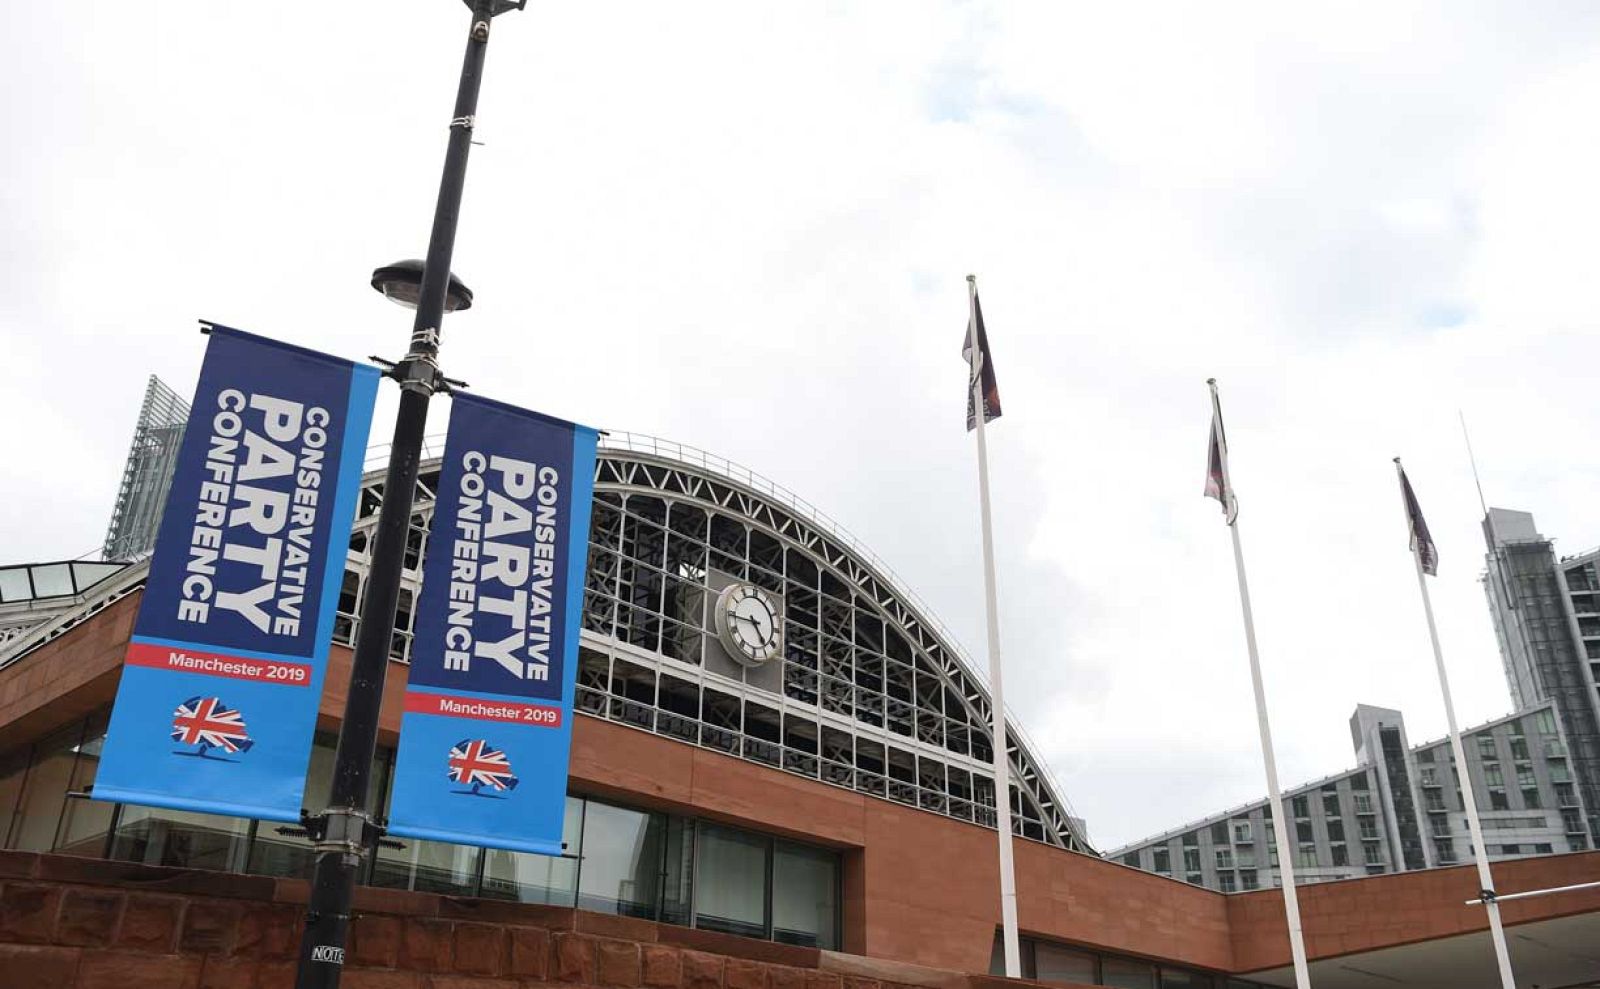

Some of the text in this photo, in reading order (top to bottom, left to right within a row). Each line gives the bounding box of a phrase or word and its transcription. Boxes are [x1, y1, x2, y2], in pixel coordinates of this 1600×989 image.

[177, 388, 246, 624] CONFERENCE
[214, 393, 304, 634] PARTY
[274, 407, 330, 637] CONSERVATIVE
[443, 450, 487, 672] CONFERENCE
[474, 455, 536, 679] PARTY
[527, 466, 559, 681] CONSERVATIVE
[169, 652, 306, 681] Manchester 2019
[439, 699, 557, 723] Manchester 2019
